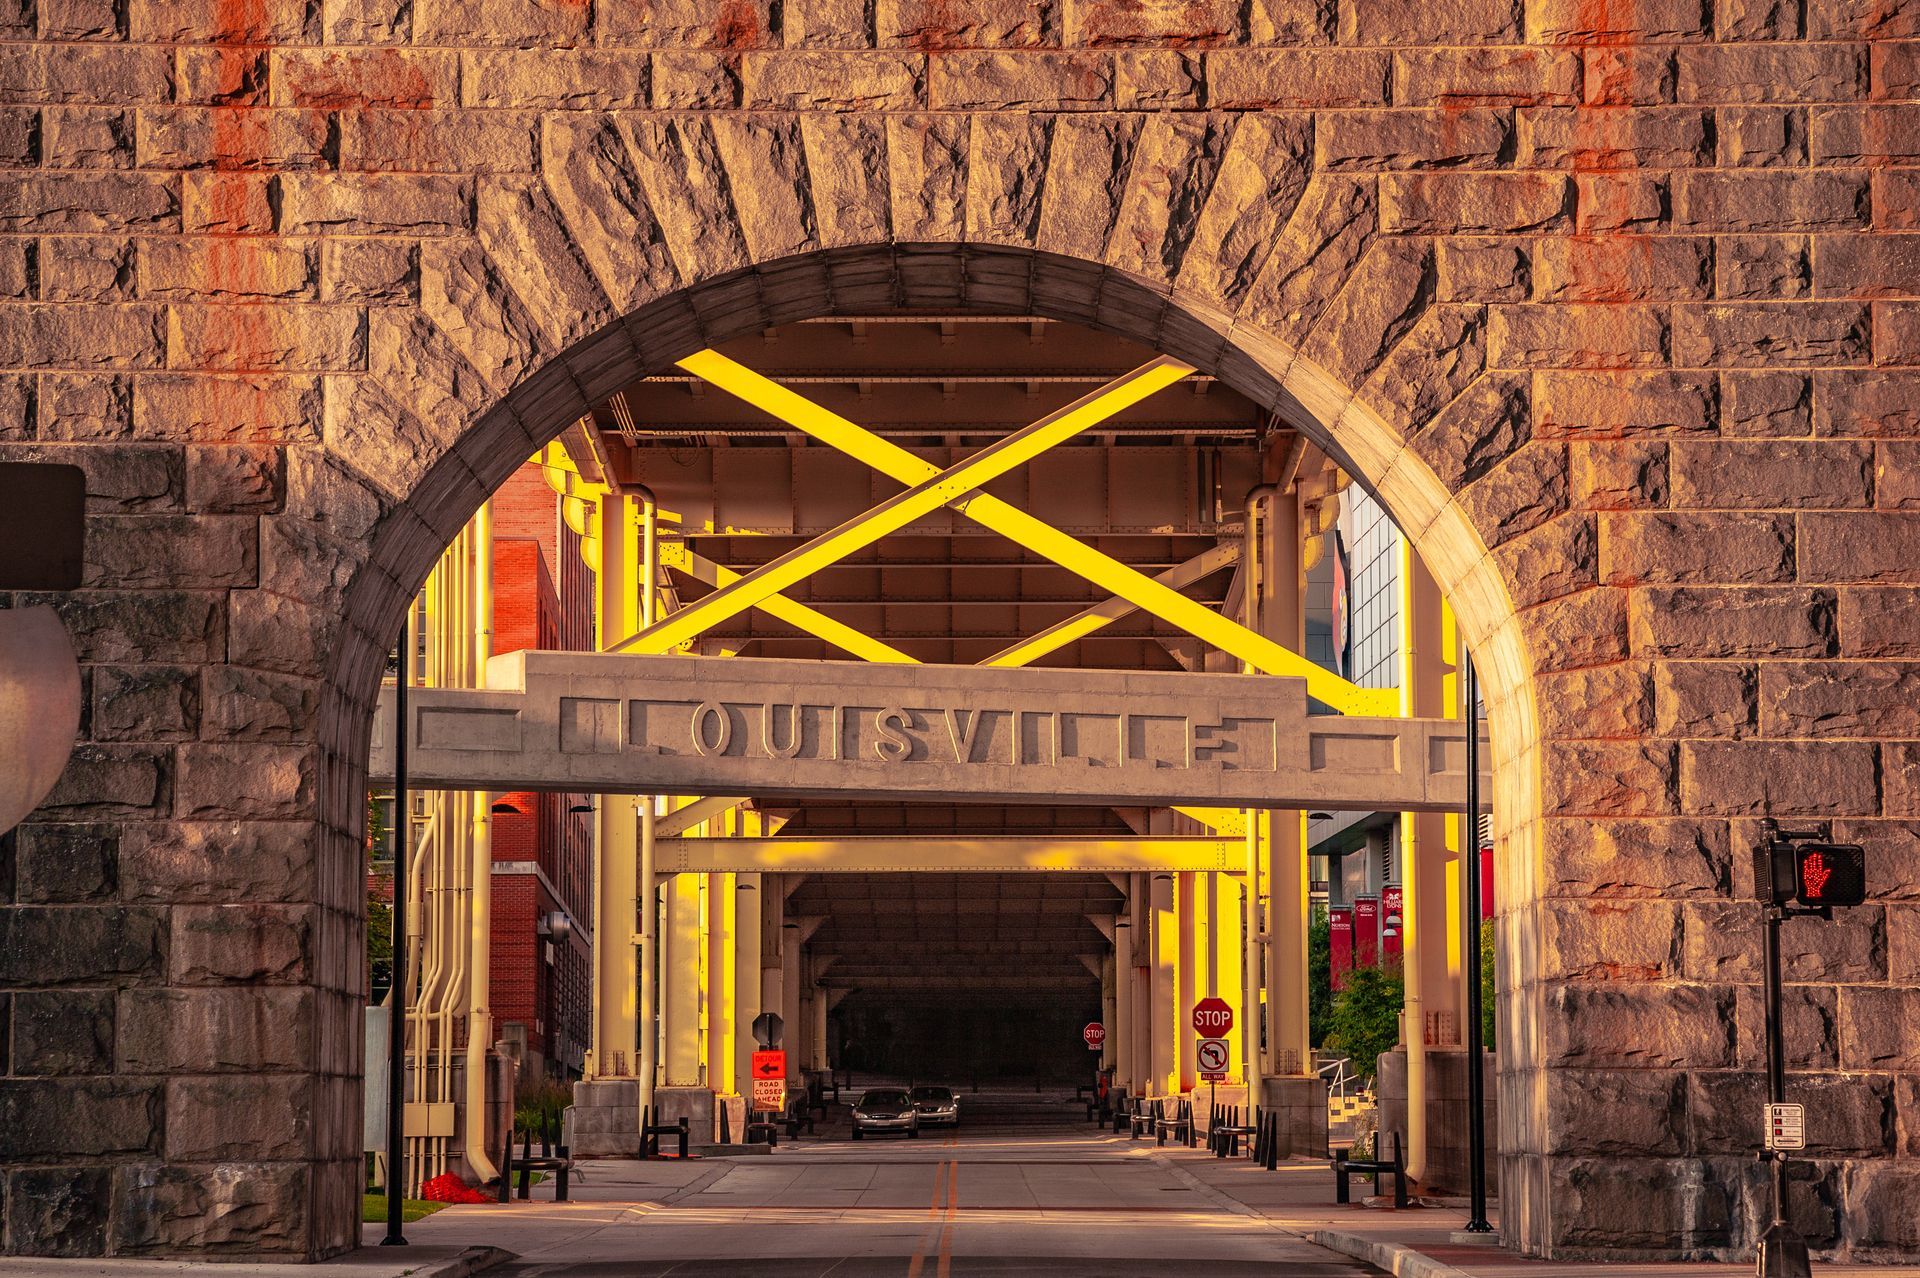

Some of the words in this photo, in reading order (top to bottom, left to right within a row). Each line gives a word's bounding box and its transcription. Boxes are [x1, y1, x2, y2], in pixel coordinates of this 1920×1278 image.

[620, 699, 1225, 771] LOUISVILLE
[1195, 1011, 1231, 1026] STOP
[1085, 1029, 1105, 1039] STOP
